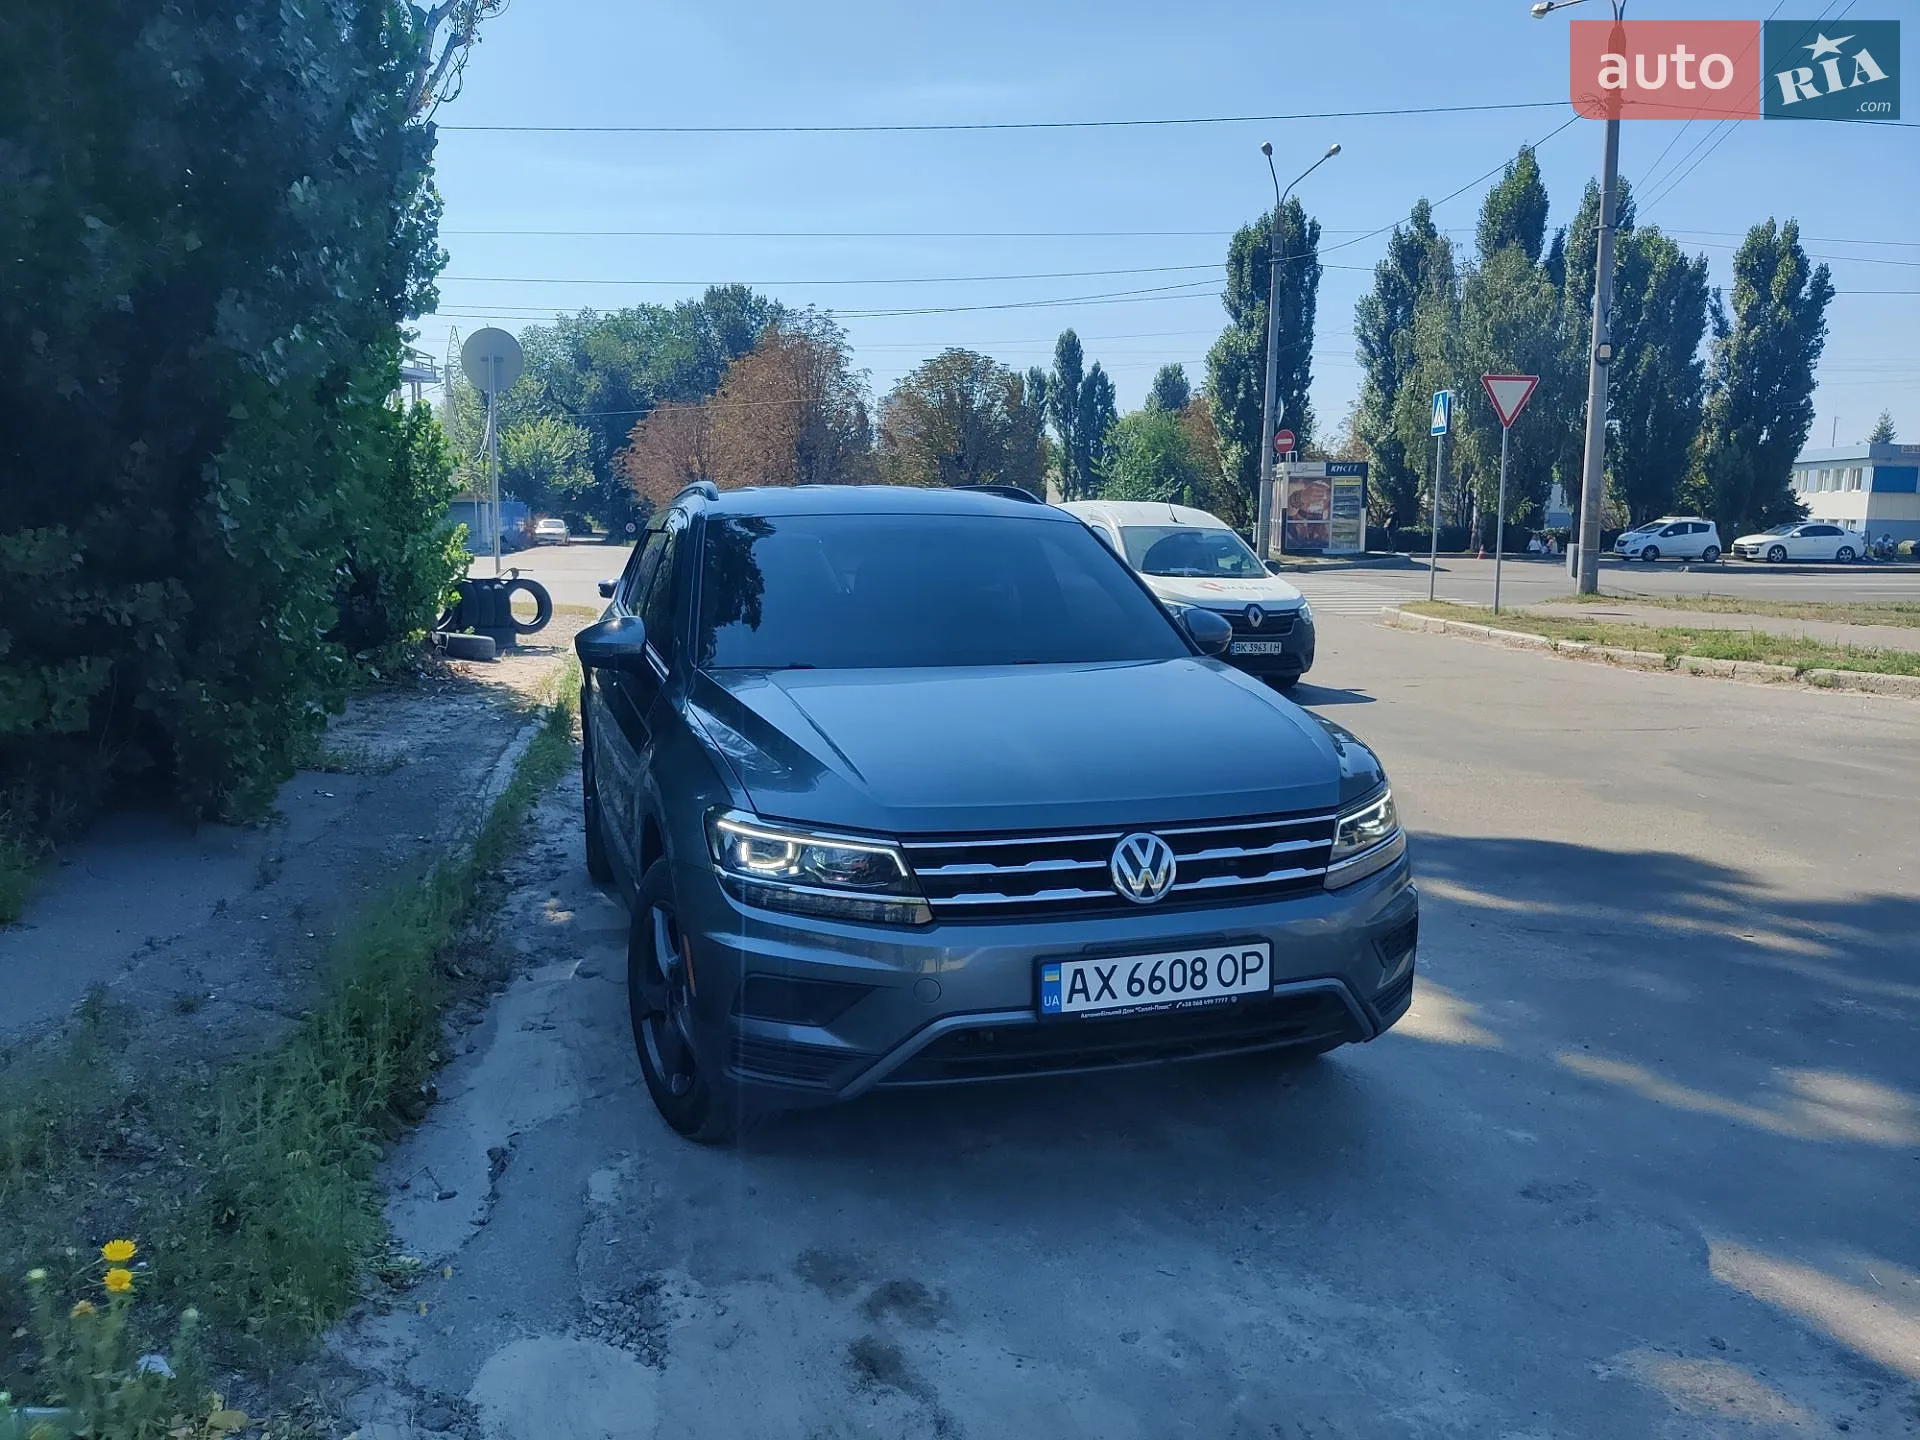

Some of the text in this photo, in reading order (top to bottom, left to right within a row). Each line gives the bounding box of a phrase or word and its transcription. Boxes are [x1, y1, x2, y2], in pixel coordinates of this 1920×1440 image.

[1066, 950, 1264, 1004] AX 6608 OP
[1043, 995, 1060, 1008] UA
